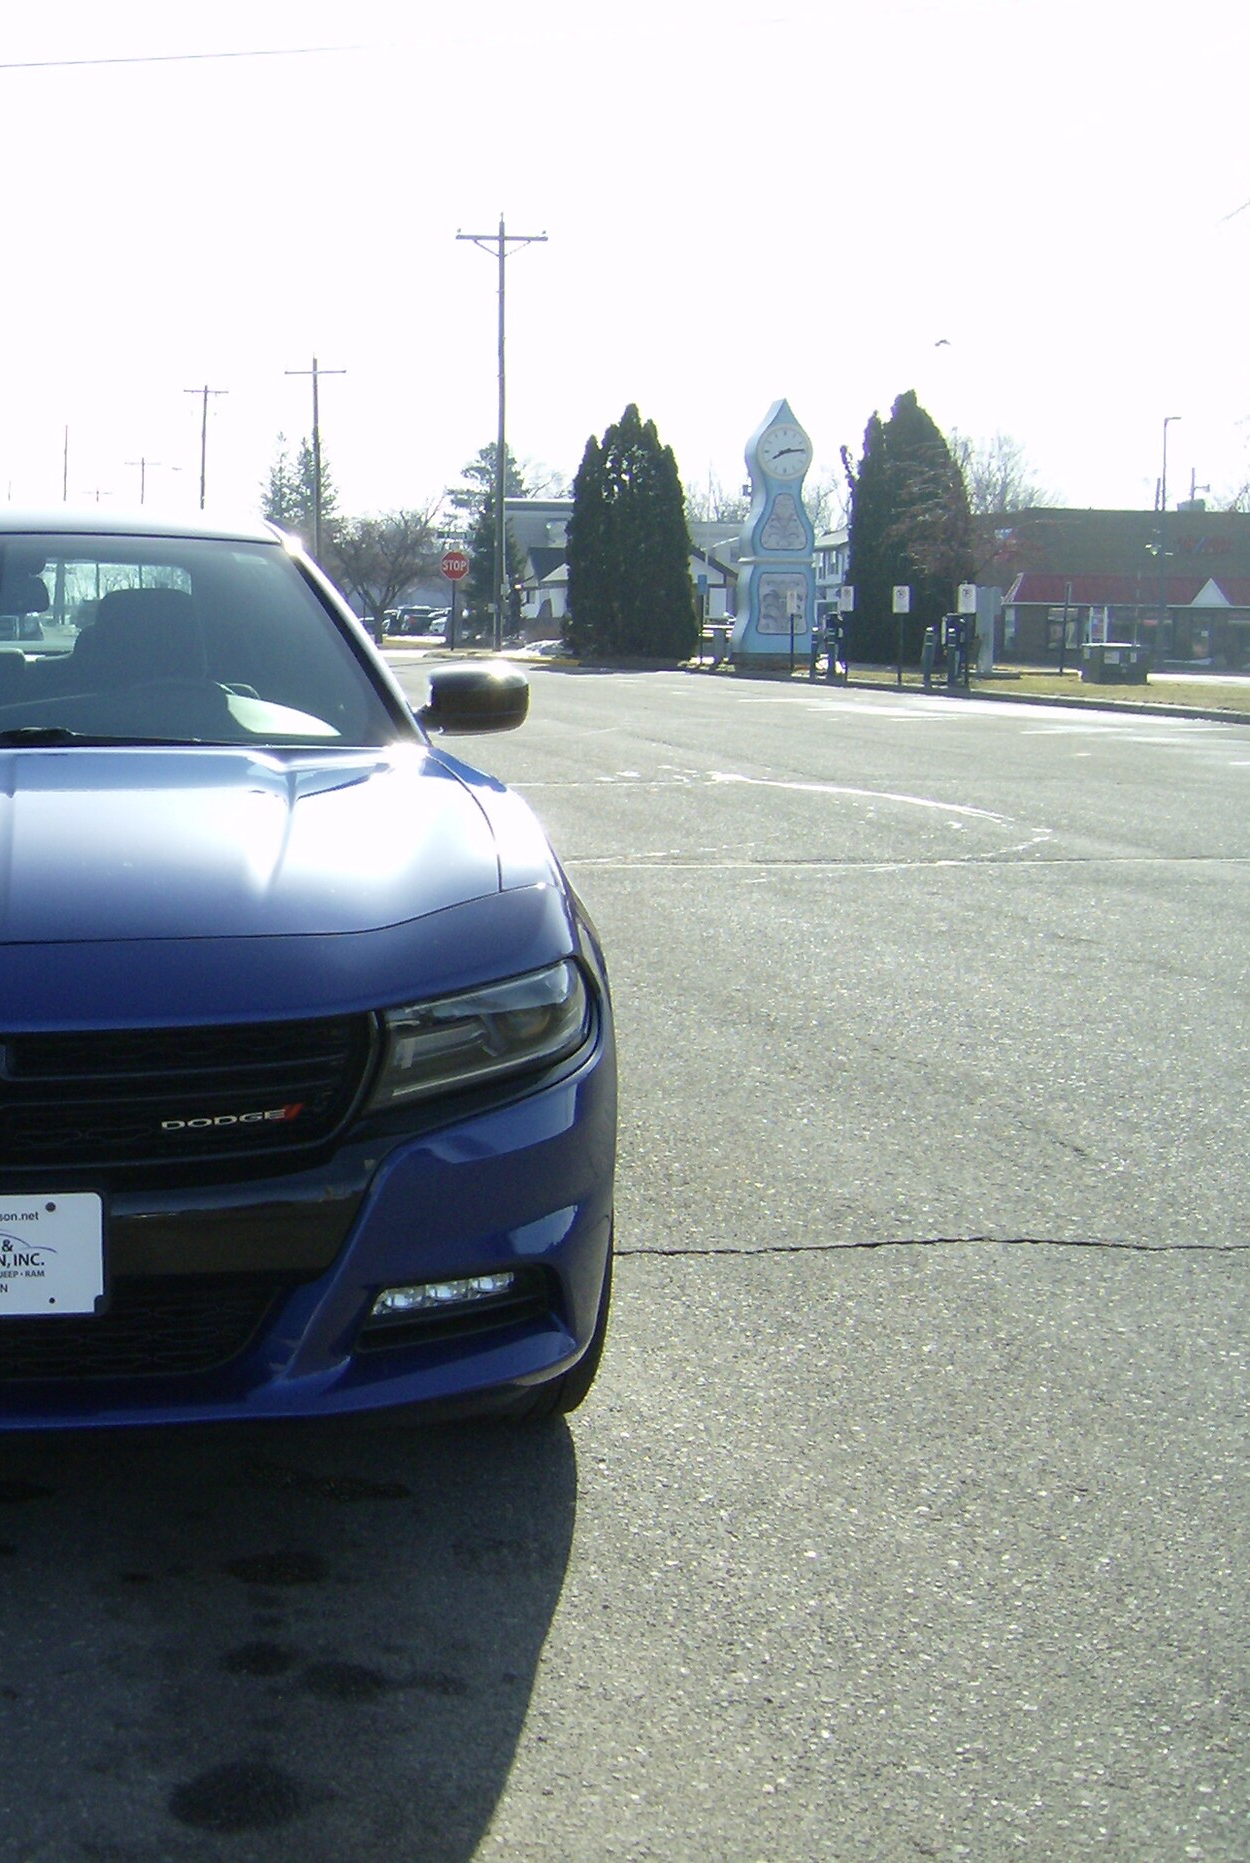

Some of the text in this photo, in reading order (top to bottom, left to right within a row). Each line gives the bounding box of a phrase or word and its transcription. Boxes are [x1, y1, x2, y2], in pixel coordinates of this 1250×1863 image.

[442, 560, 467, 571] STOP
[161, 1108, 286, 1130] DODGE
[1, 1239, 13, 1252] &
[13, 1253, 45, 1267] INC.
[0, 1270, 19, 1279] JEEP
[24, 1269, 45, 1278] RAM
